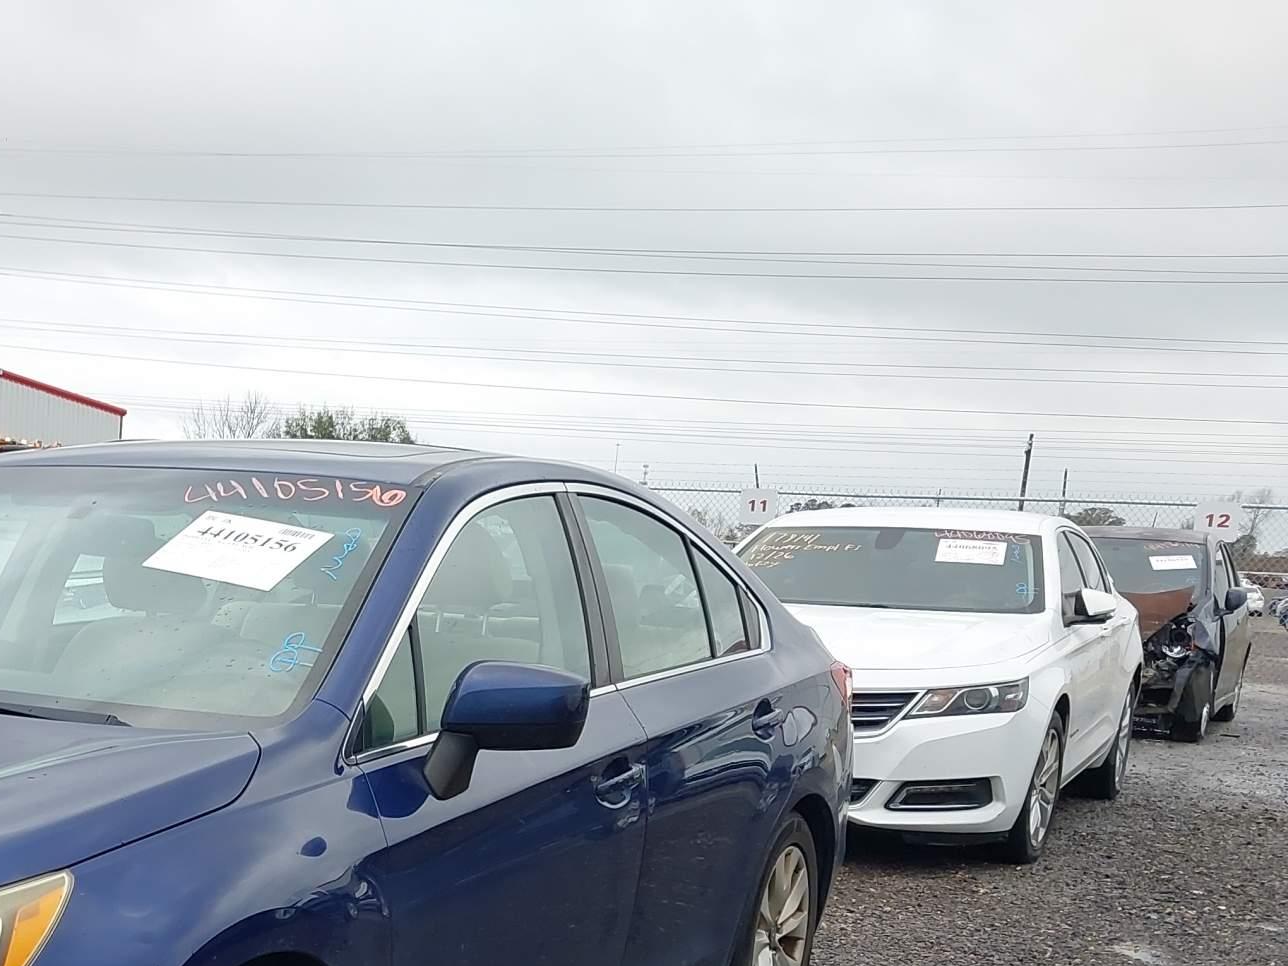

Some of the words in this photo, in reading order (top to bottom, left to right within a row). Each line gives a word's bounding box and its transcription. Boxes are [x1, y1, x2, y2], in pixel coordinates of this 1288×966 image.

[748, 499, 767, 513] 11
[1206, 513, 1231, 528] 12
[197, 525, 301, 553] 44105156
